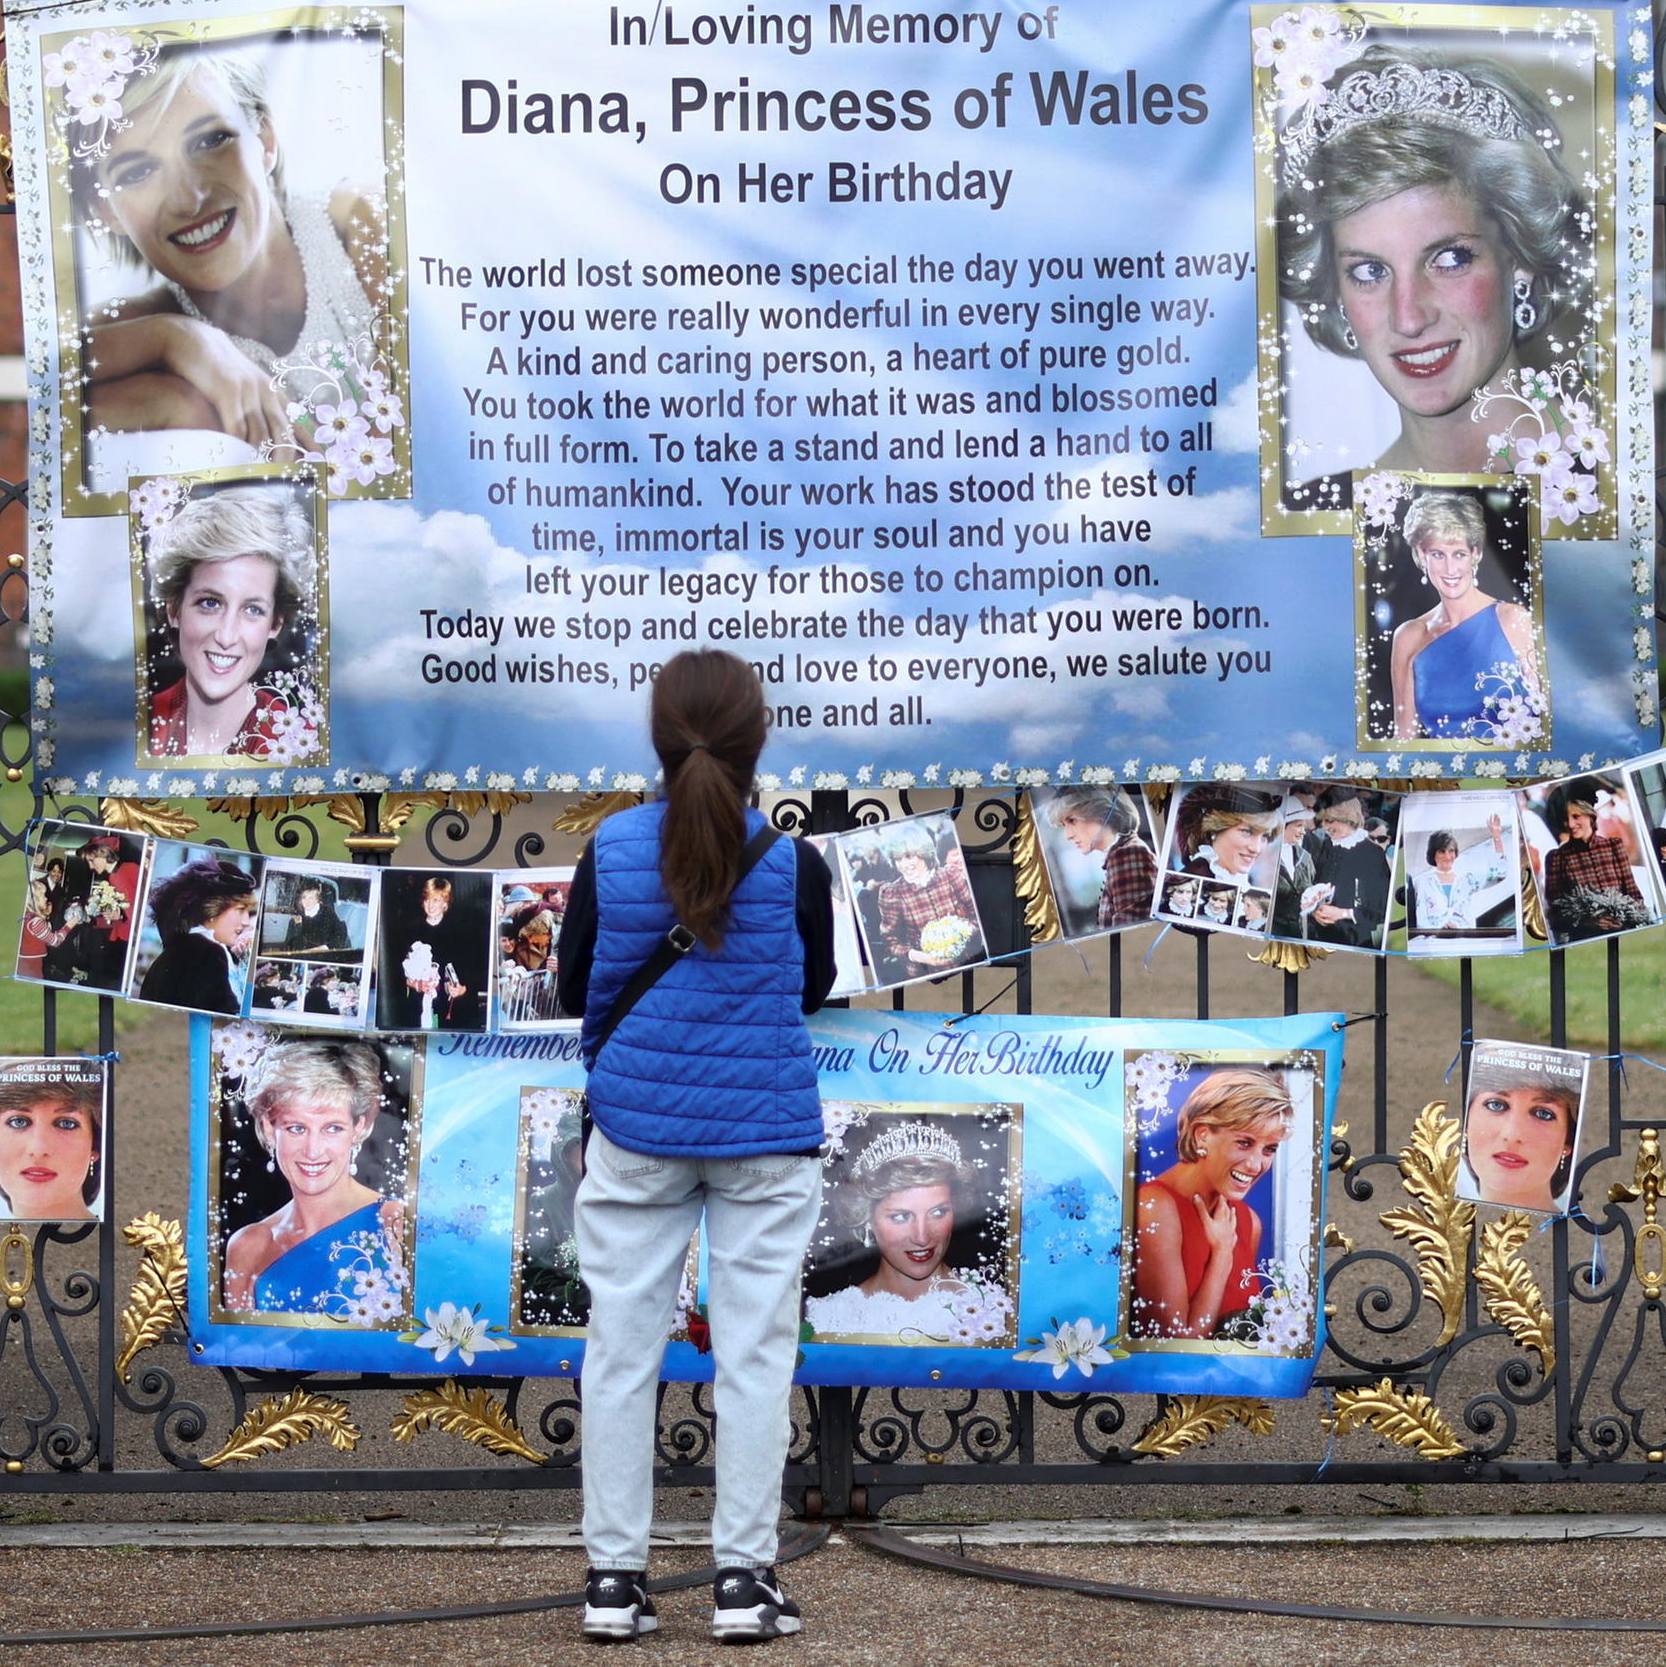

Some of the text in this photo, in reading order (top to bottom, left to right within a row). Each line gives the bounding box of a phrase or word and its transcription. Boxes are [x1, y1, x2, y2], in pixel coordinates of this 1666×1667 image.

[610, 1, 1060, 56] In Loving Memory of
[461, 69, 1209, 145] Diana, Princess of Wales
[659, 160, 1013, 211] On Her Birthday
[419, 250, 1258, 293] The world lost someone special the day you went away.
[461, 293, 1215, 340] For you were really wonderful in every single way.
[486, 335, 1190, 382] A kind and caring person, a heart of pure gold.
[462, 376, 1218, 420] You took the world for what it was and blossomed
[469, 421, 1213, 464] in full form. To take a stand and lend a hand to all
[487, 465, 1198, 508] of humankind. Your work has stood the test of
[531, 514, 1152, 559] time, immortal is your soul and you have
[526, 558, 1159, 604] left your legacy for those to champion on.
[419, 599, 1269, 648] Today we stop and celebrate the day that you were born.
[421, 653, 497, 685] Good
[504, 653, 618, 690] wishes,
[747, 653, 784, 684] nd
[796, 653, 858, 683] love
[867, 653, 898, 682] to
[908, 655, 1056, 688] everyone,
[1066, 654, 1108, 678] we
[1117, 645, 1207, 677] salute
[1216, 650, 1271, 683] you
[822, 696, 878, 728] and
[888, 695, 932, 727] all.
[16, 1064, 81, 1072] GOD BLESS THE
[48, 1073, 62, 1083] OF
[65, 1073, 101, 1083] WALES
[868, 1028, 911, 1074] On
[919, 1029, 980, 1076] Her
[979, 1029, 1115, 1090] Birthday
[1476, 1054, 1582, 1078] PRINCESS OF WALES
[1544, 1055, 1563, 1064] THE
